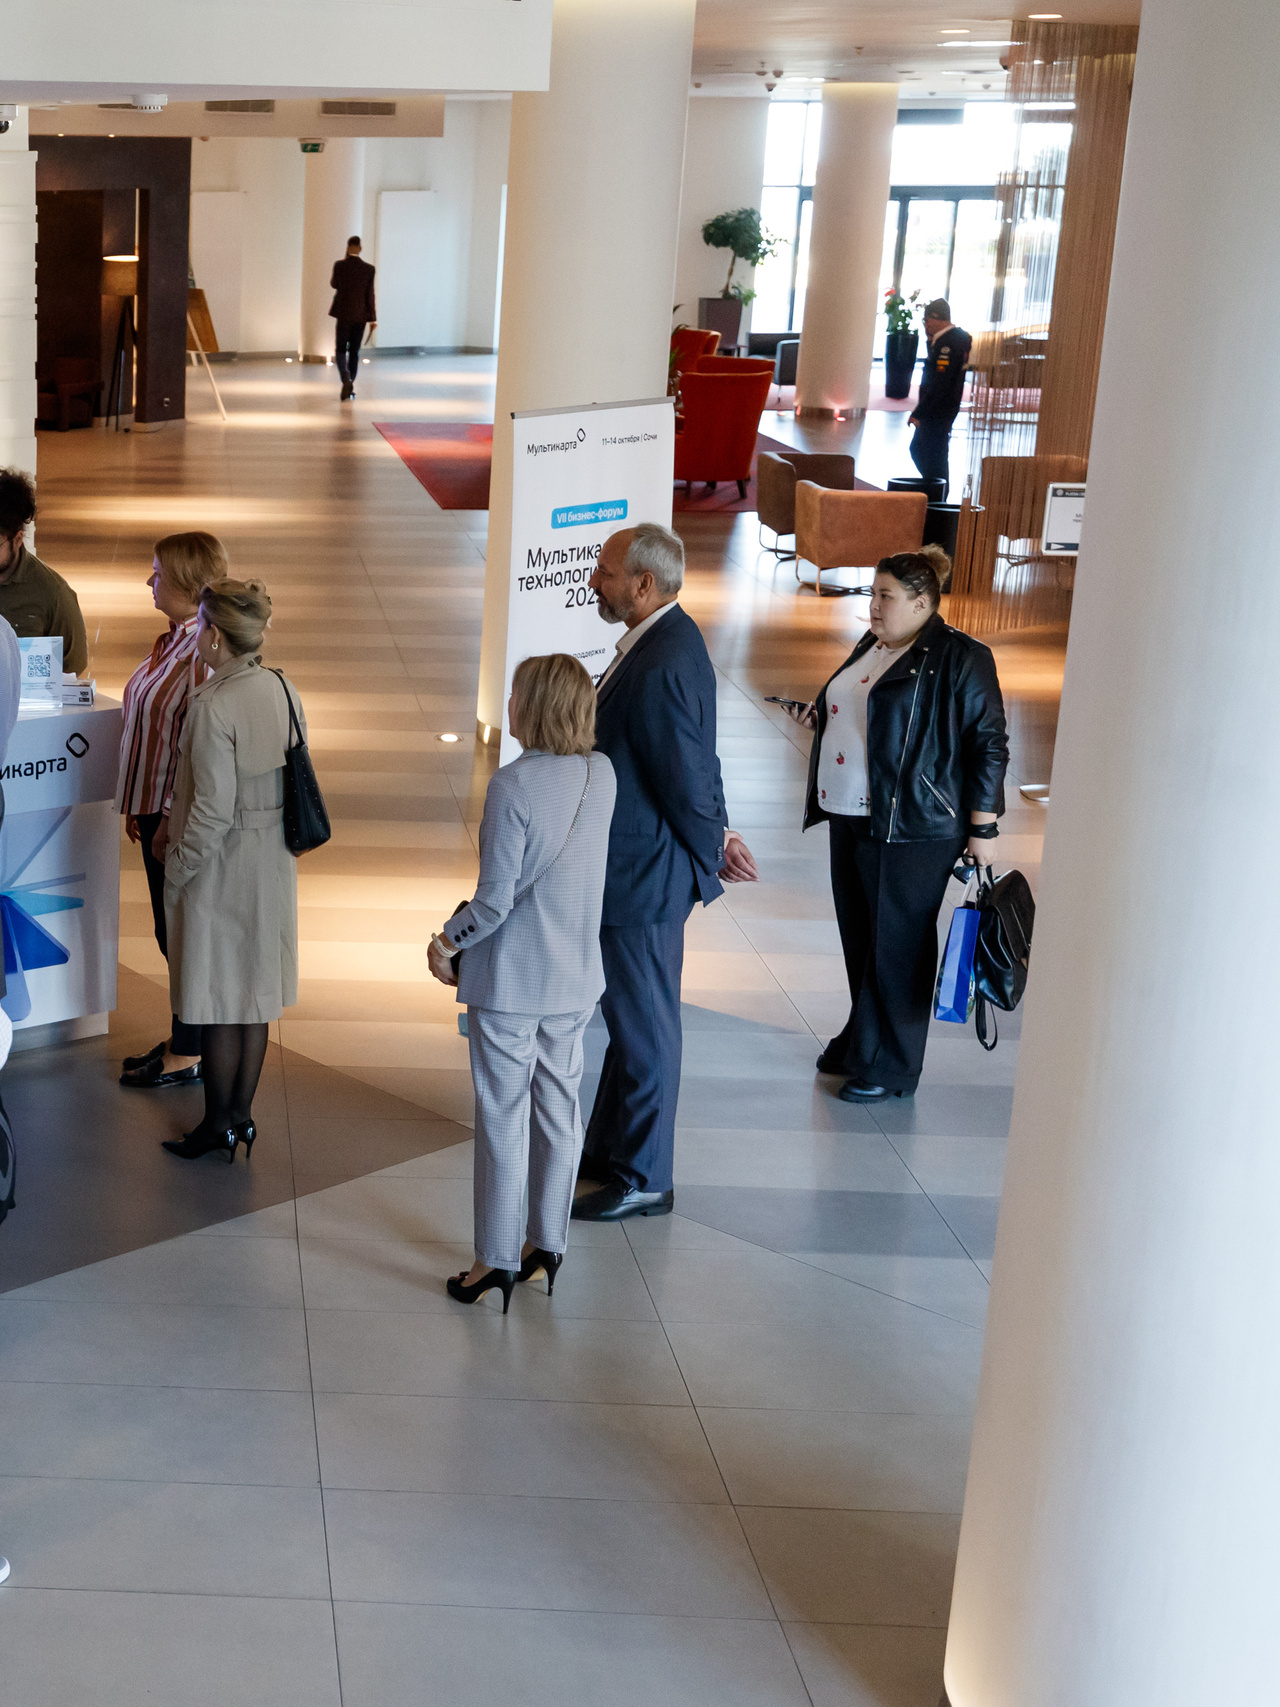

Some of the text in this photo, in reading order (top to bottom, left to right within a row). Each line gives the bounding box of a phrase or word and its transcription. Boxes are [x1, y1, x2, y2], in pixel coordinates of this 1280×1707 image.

[526, 440, 578, 457] Мультикарта
[618, 435, 640, 445] октября
[643, 432, 658, 442] Сочи
[556, 506, 625, 525] VII бизнес-форум
[527, 543, 602, 571] Мультика
[517, 565, 598, 592] технолог
[565, 586, 600, 608] 202
[0, 757, 67, 780] икарта
